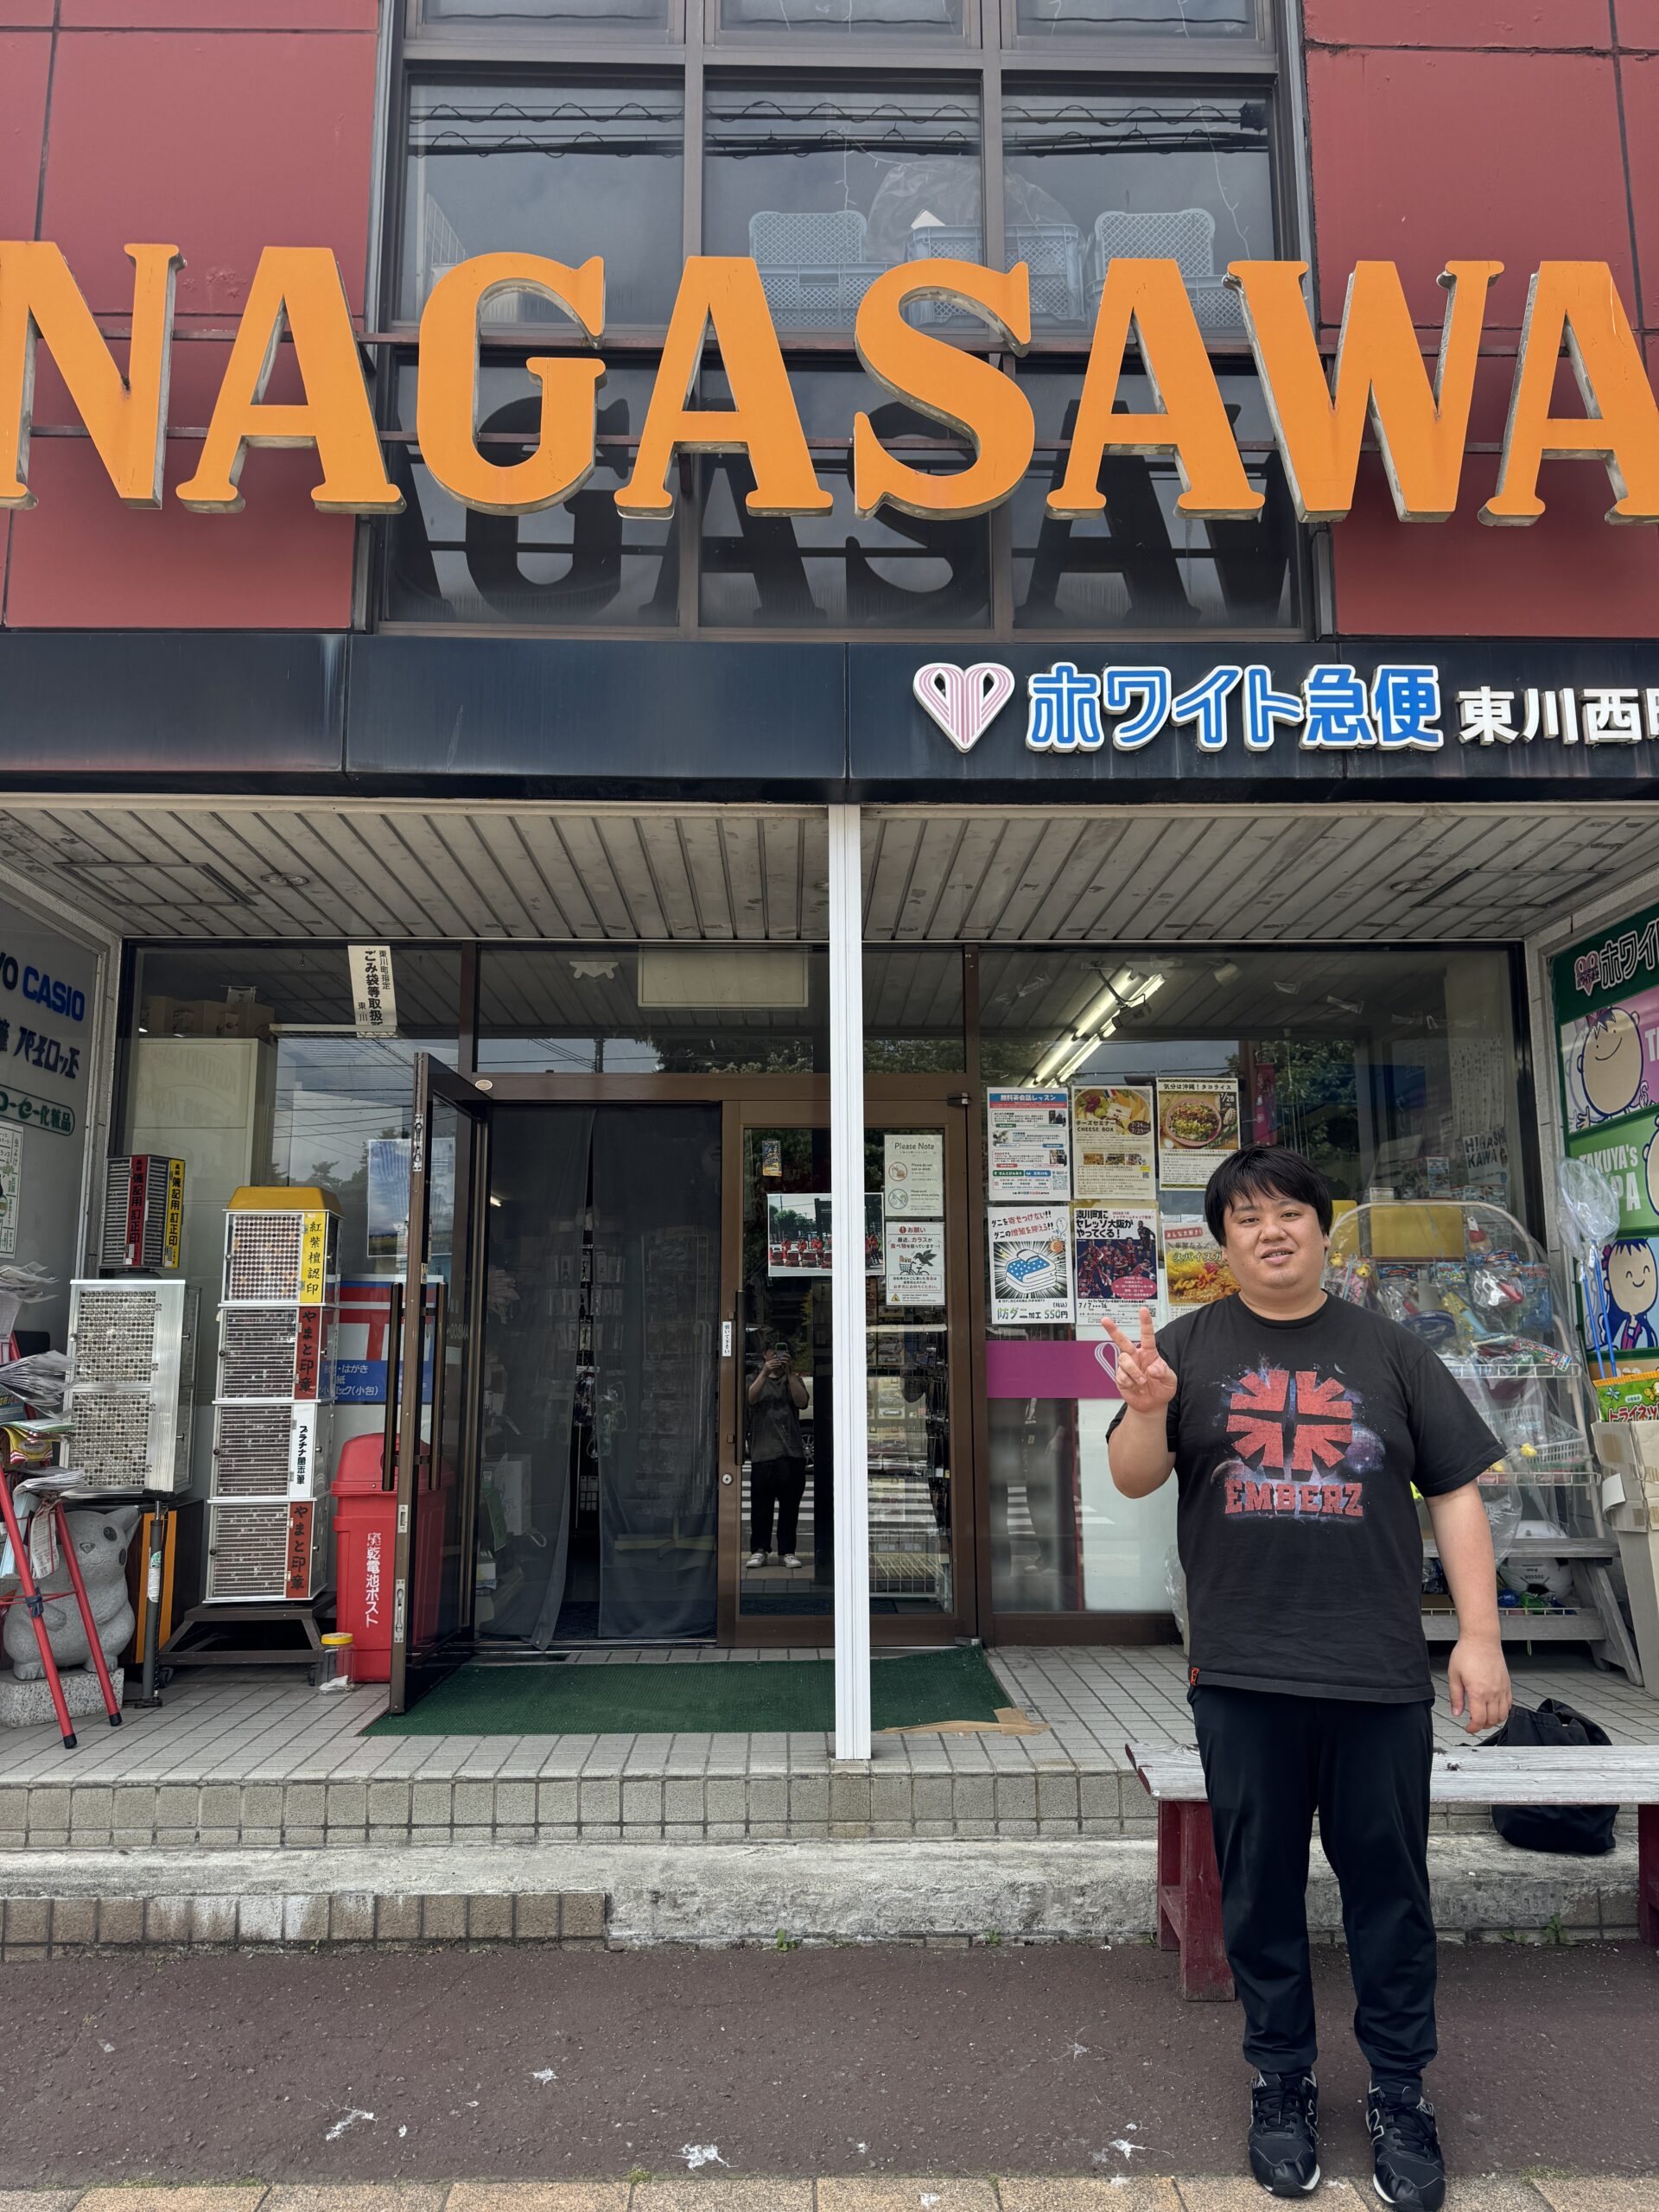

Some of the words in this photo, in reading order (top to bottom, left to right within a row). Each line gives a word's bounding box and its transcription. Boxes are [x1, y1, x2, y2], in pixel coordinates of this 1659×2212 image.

[0, 240, 1659, 525] NAGASAWA
[1027, 661, 1444, 754] ホワイト急便
[1459, 684, 1659, 745] 東川西
[378, 950, 391, 990] 東川町指定
[1599, 918, 1659, 989] ホワイ
[22, 965, 86, 1022] CASIO
[365, 950, 383, 1026] ごみ袋等取扱
[1076, 1210, 1109, 1219] 東川町に
[1076, 1219, 1134, 1229] セレッソ大阪が
[1044, 1309, 1069, 1319] 550円
[299, 1311, 316, 1392] やまと印章
[1608, 1402, 1659, 1423] トライネッ
[1224, 1478, 1363, 1517] EMBERZ
[290, 1505, 308, 1591] やまと印章
